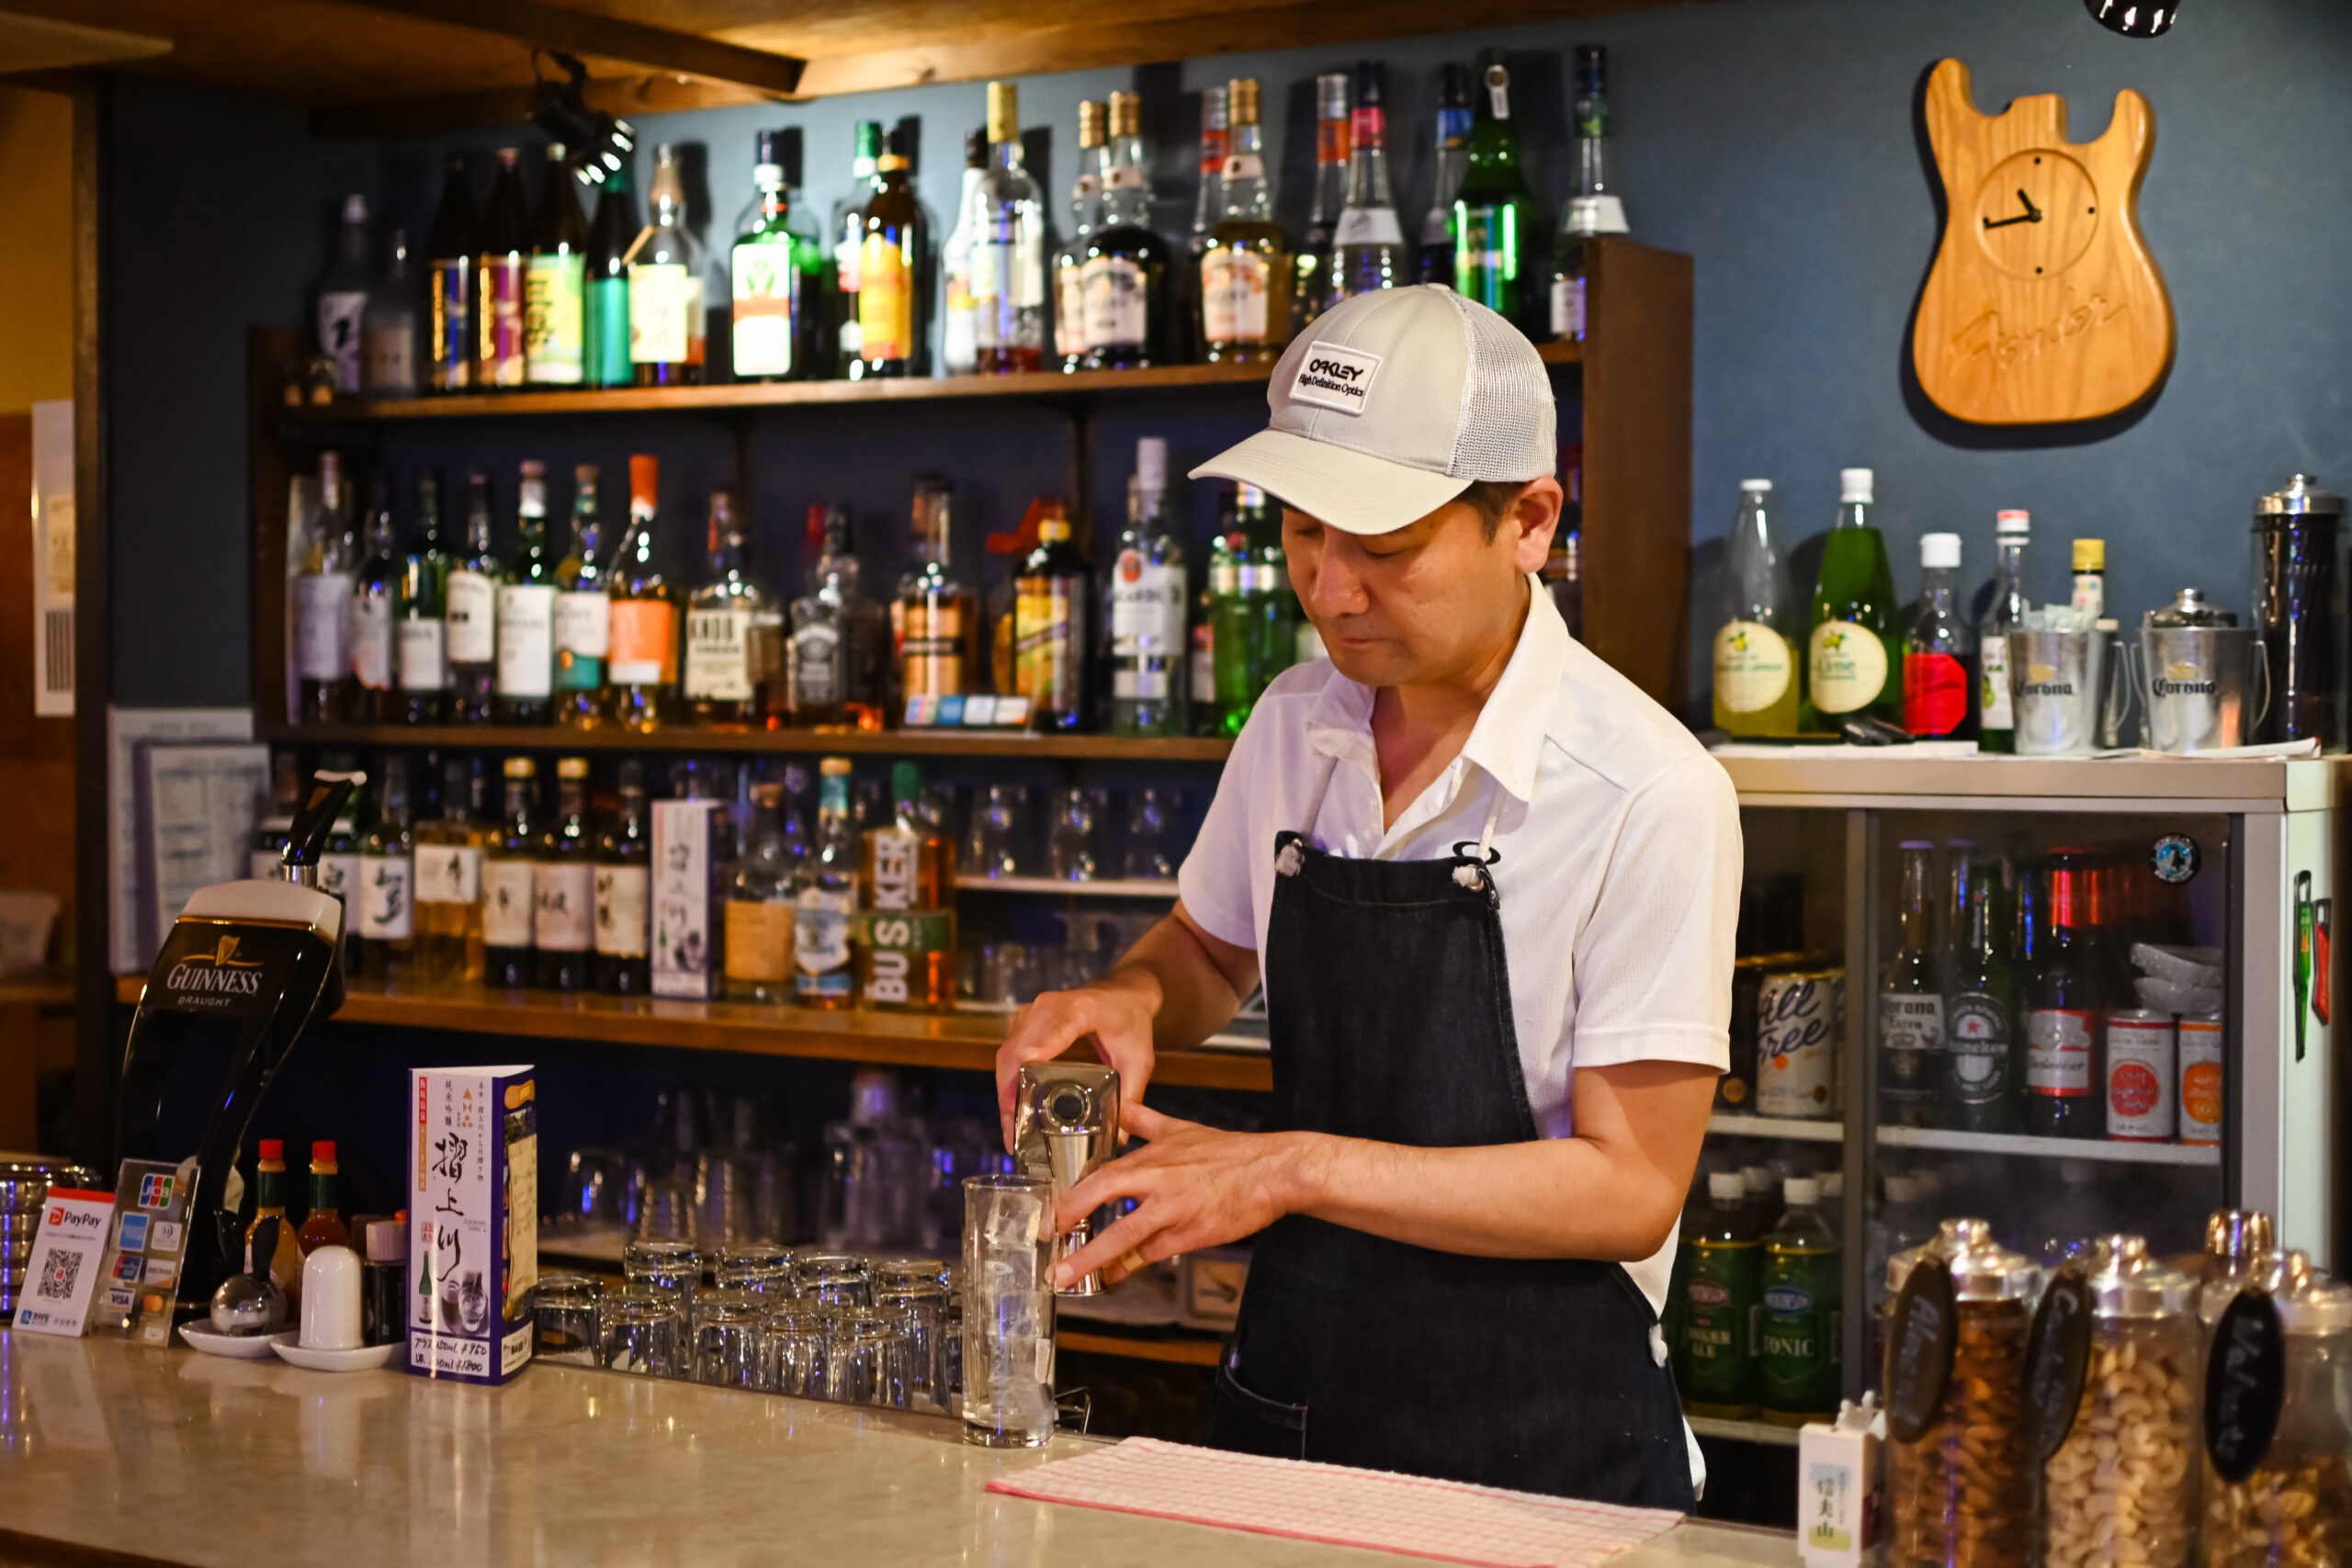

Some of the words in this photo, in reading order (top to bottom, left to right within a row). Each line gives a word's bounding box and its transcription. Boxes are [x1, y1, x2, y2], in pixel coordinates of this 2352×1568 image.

[1309, 358, 1364, 381] OAKLEY
[1298, 373, 1312, 387] High
[1312, 376, 1341, 391] Definition
[1341, 383, 1364, 397] Optics
[2016, 680, 2074, 697] Corona
[2153, 678, 2218, 698] Corona
[873, 830, 910, 1003] BUSKER
[166, 963, 263, 994] GUINNESS
[177, 996, 232, 1008] DRAUGHT
[63, 1212, 101, 1229] PayPay
[111, 1293, 130, 1305] VISA
